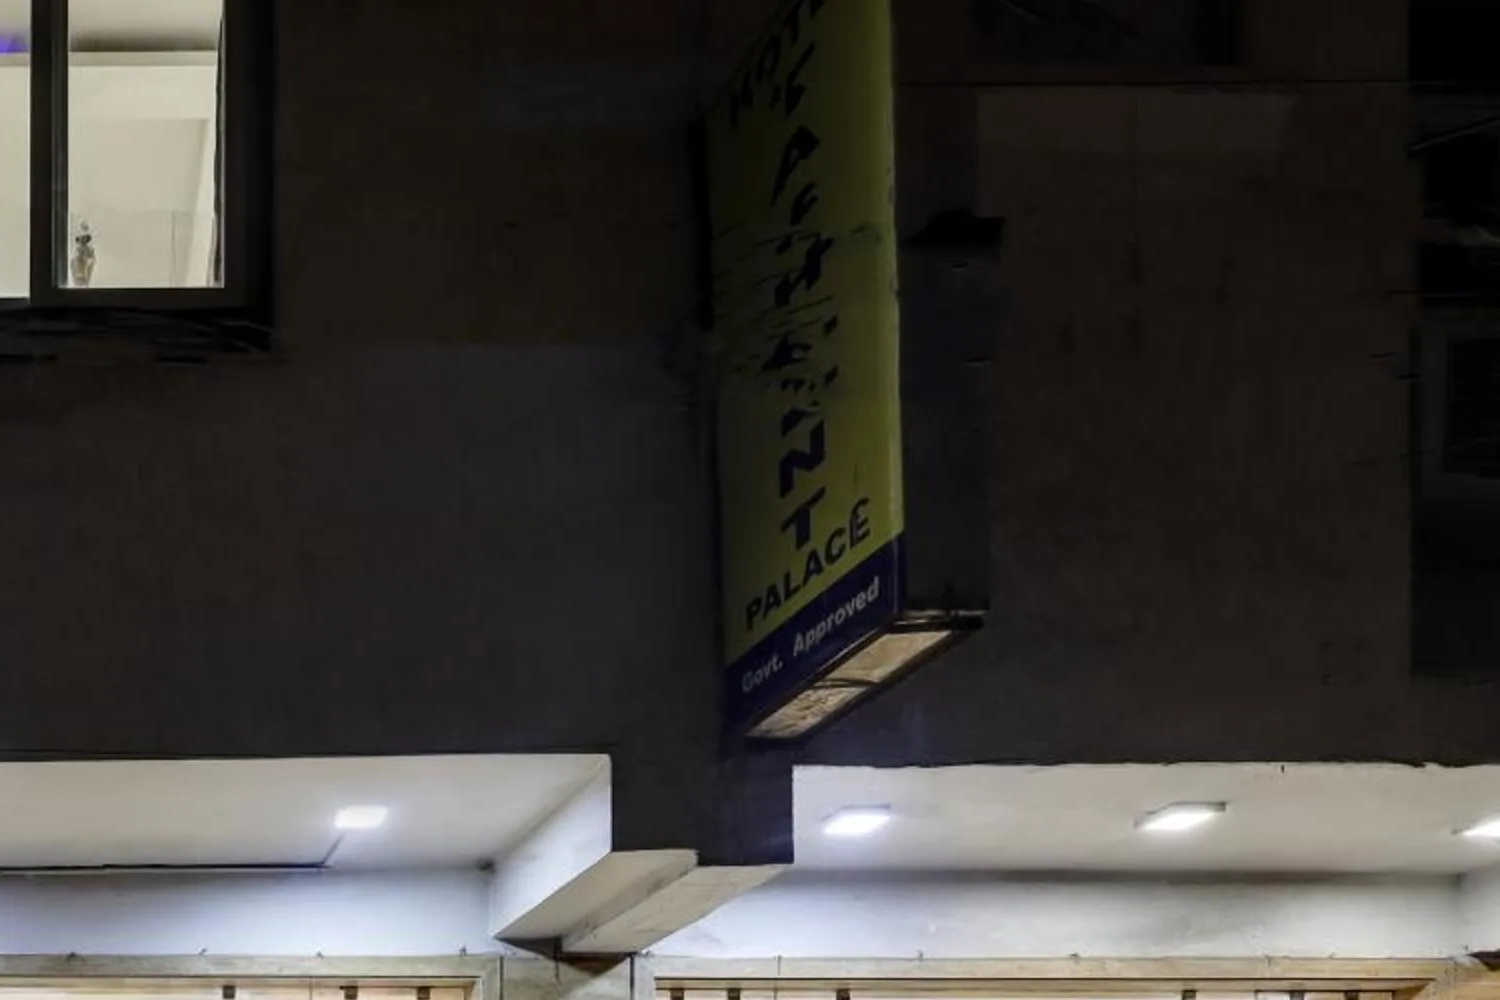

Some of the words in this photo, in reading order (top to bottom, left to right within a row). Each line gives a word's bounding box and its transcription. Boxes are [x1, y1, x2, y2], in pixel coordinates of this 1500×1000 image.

[746, 497, 872, 633] PALACE
[741, 653, 786, 695] Govt.
[792, 575, 881, 658] Approved
